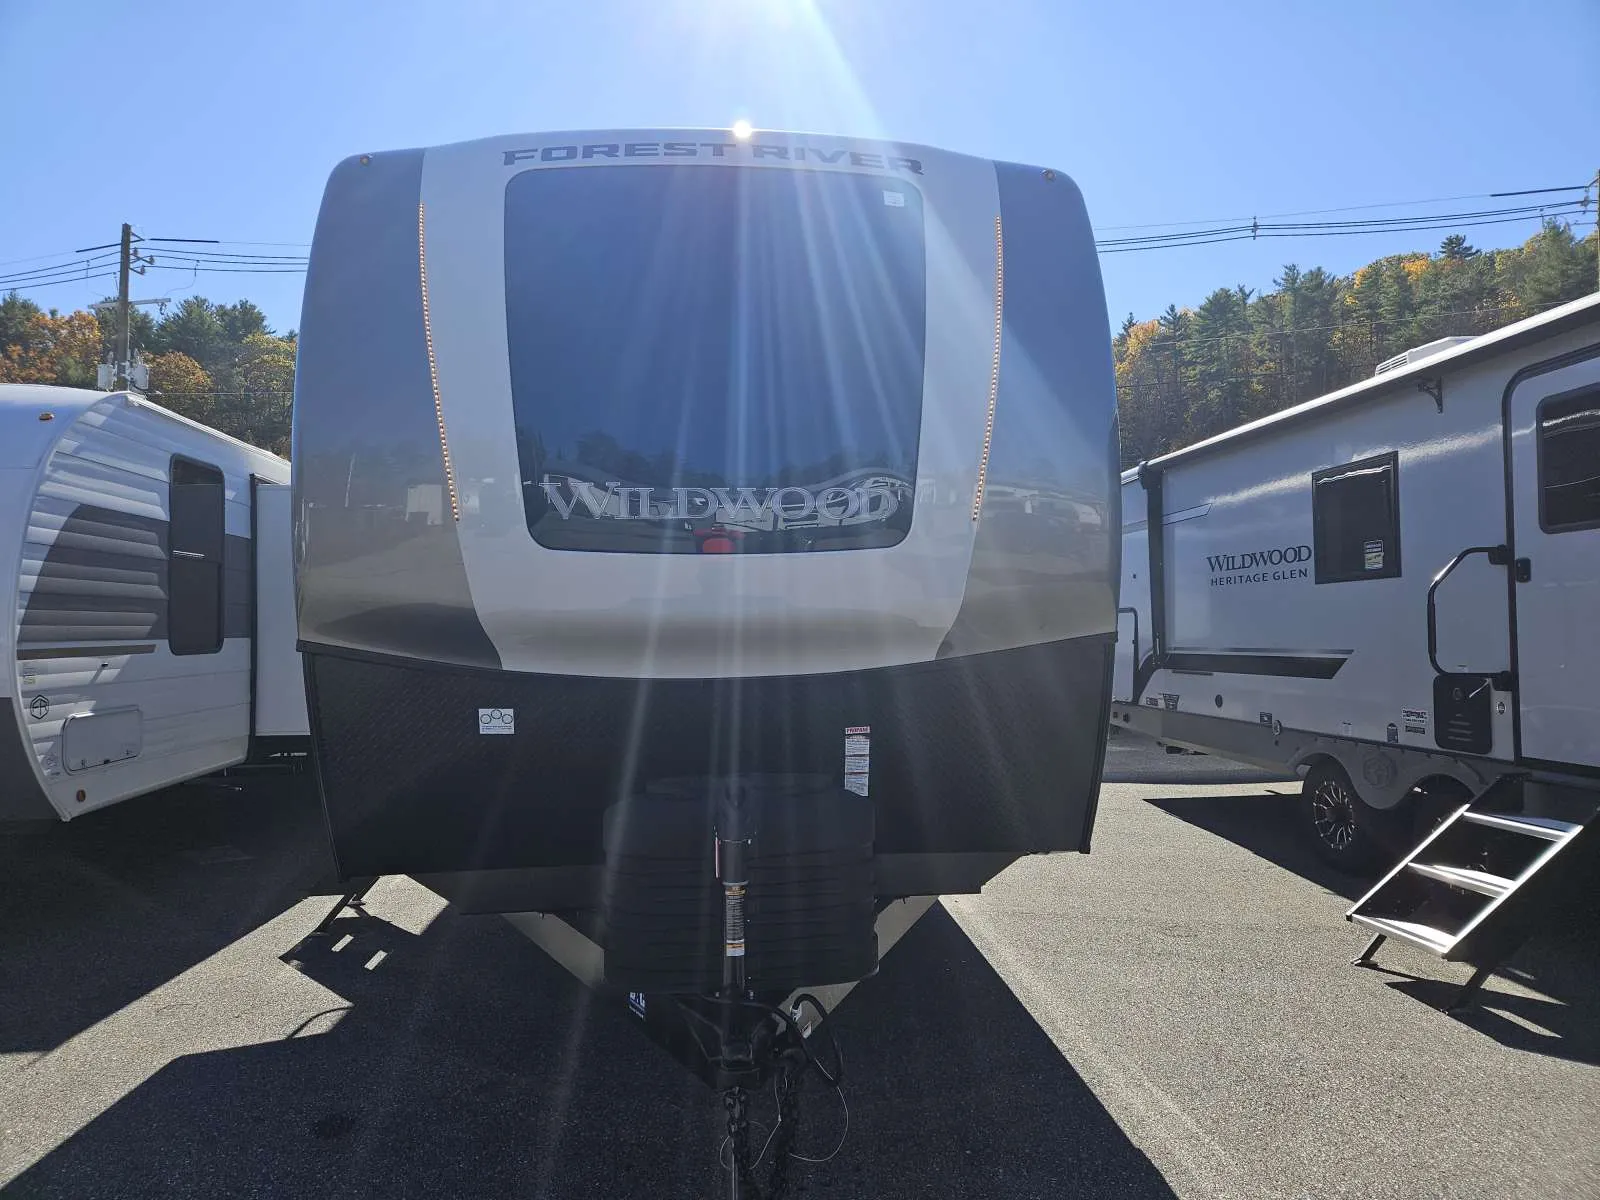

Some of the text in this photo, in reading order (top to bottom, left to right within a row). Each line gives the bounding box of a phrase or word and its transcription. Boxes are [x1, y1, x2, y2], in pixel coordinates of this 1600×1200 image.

[502, 142, 925, 176] FOREST RIVER
[538, 481, 901, 521] WILDWOOD
[1206, 545, 1313, 573] WILDWOOD
[1210, 568, 1309, 587] HERITAGE GLEN
